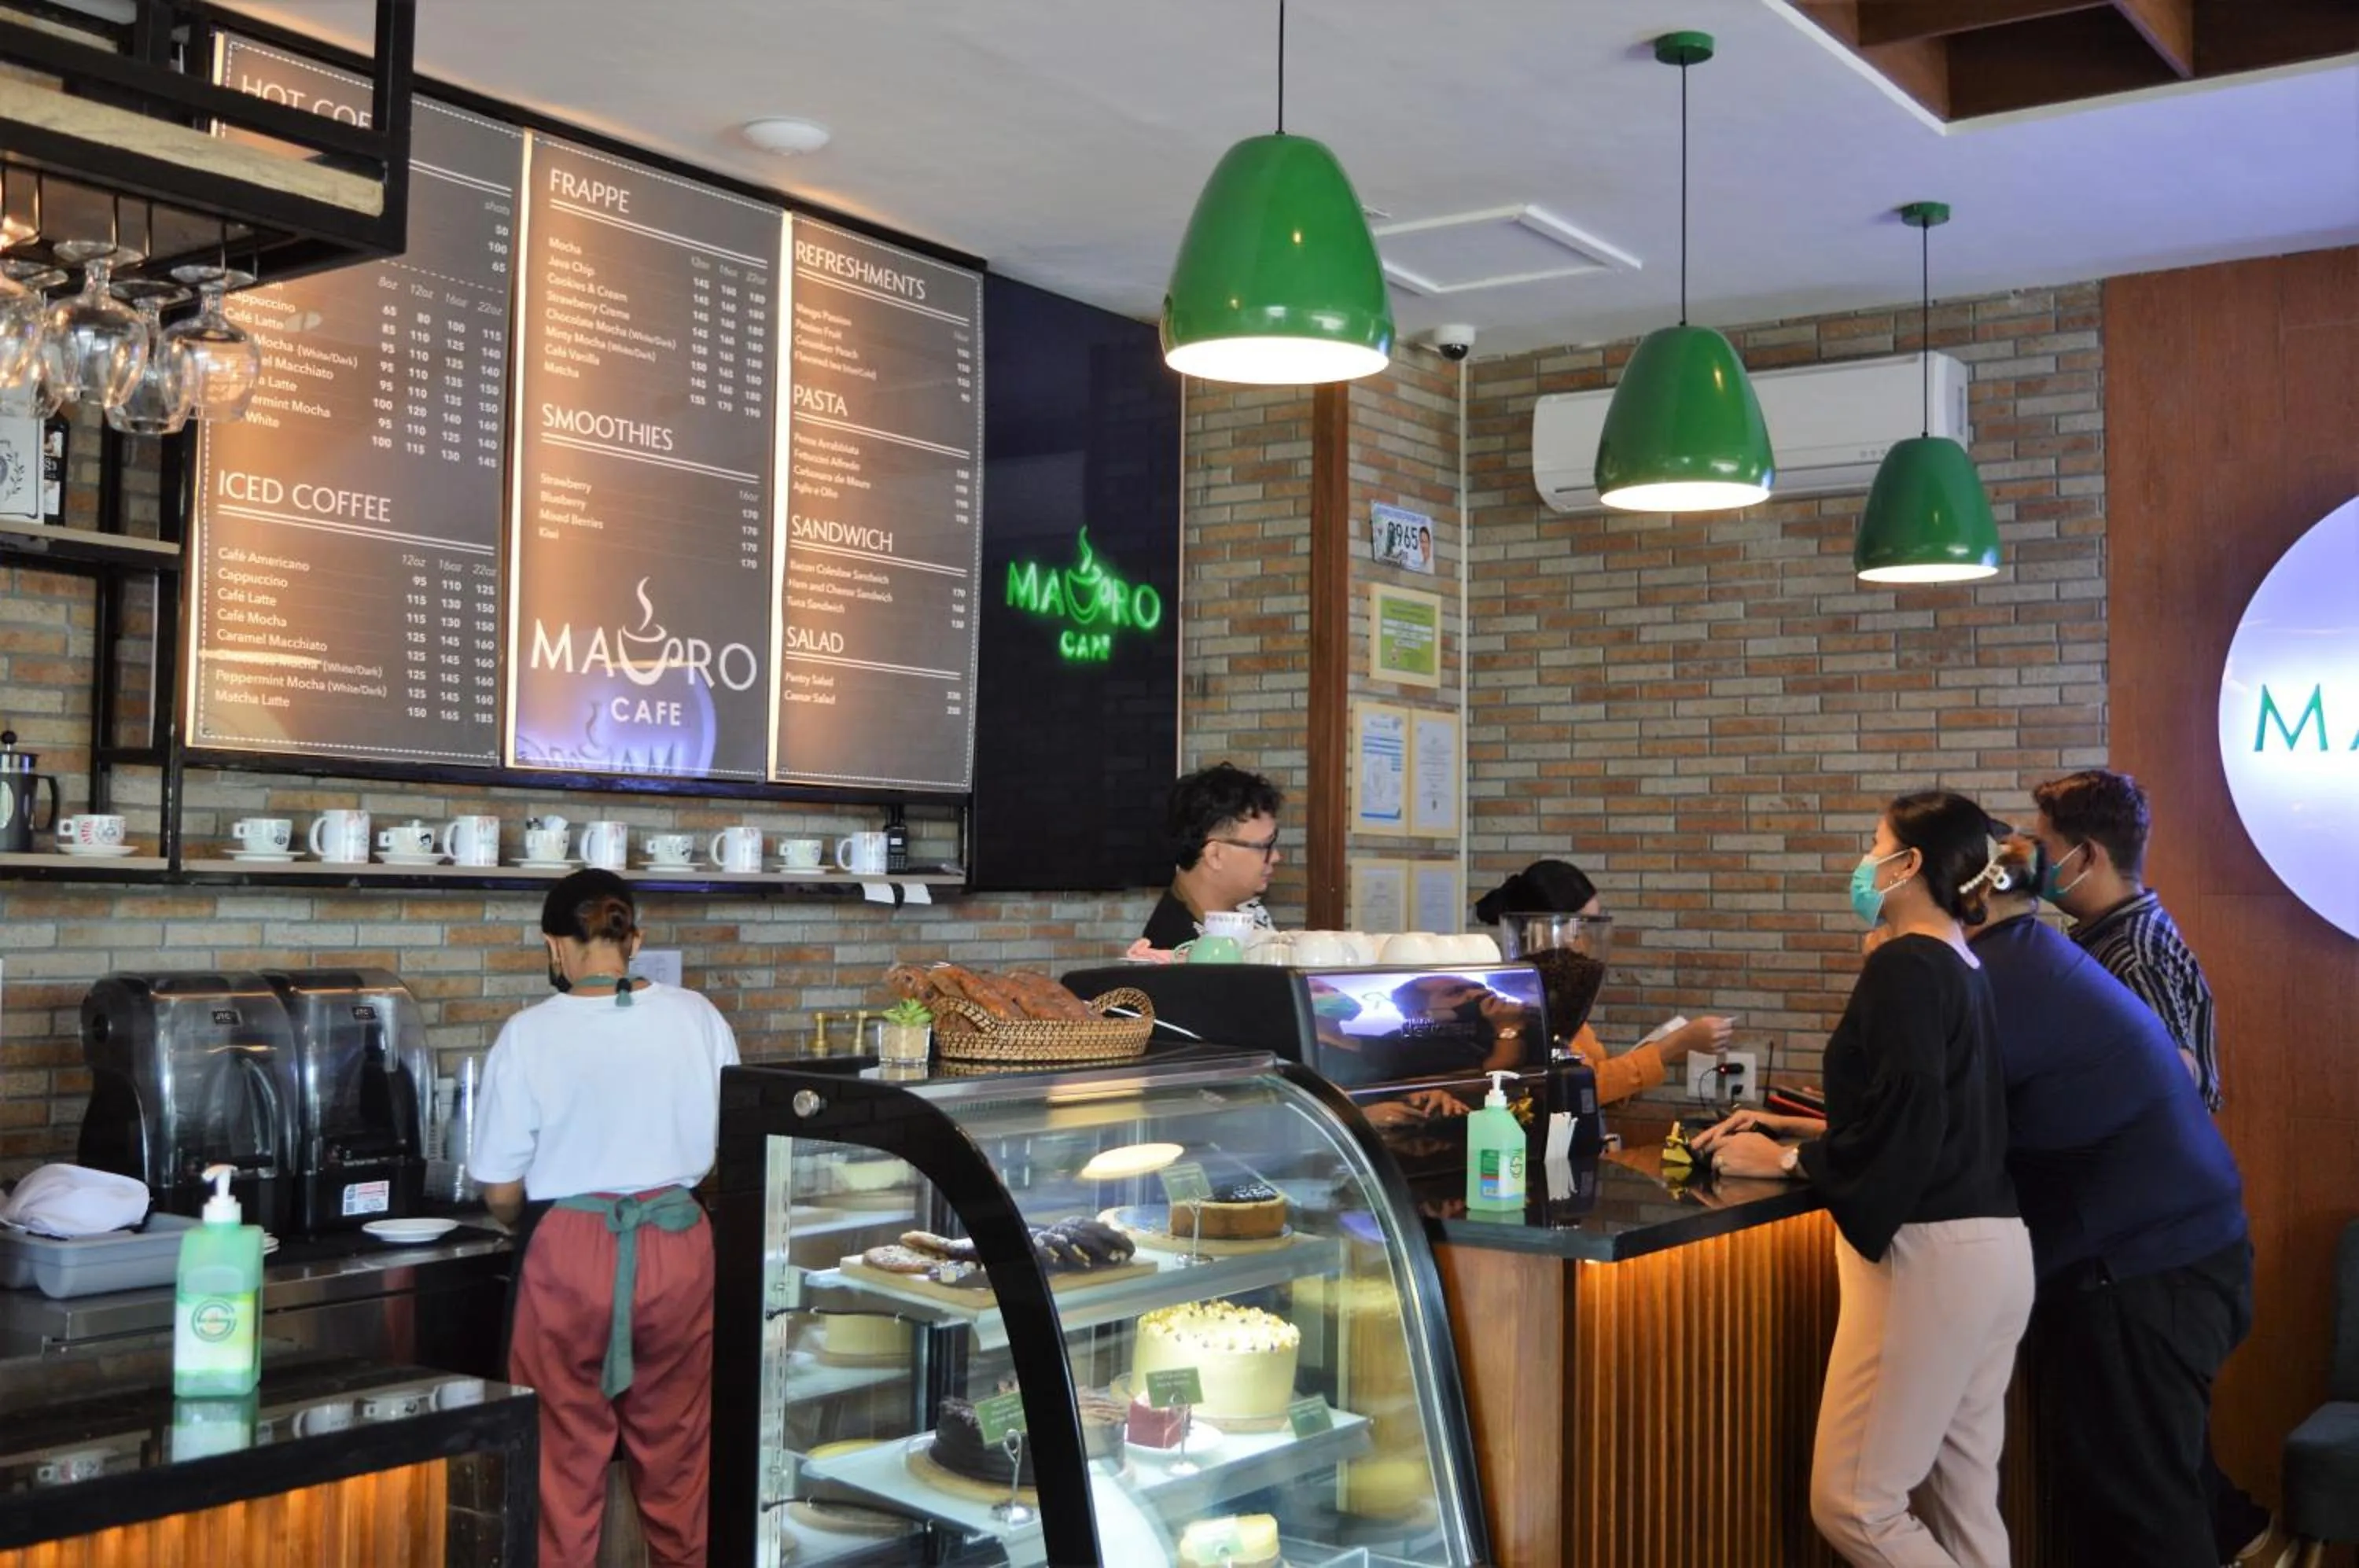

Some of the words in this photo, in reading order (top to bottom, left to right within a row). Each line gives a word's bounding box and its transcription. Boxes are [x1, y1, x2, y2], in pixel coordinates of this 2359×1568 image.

[550, 167, 631, 213] FRAPPE
[549, 237, 581, 255] Mocha
[796, 240, 926, 300] REFRESHMENTS
[547, 272, 586, 292] Cookies
[546, 290, 598, 314] Strawberry
[255, 315, 284, 329] Latte
[595, 319, 627, 337] Mocha
[254, 333, 293, 352] Mocha
[575, 332, 606, 349] Mocha
[275, 357, 334, 380] Macchiato
[409, 368, 428, 380] 110
[268, 377, 298, 392] Latte
[408, 387, 427, 399] 110
[292, 401, 331, 418] Mocha
[374, 398, 392, 410] 100
[793, 385, 848, 417] PASTA
[245, 412, 280, 428] White
[407, 424, 425, 436] 110
[542, 403, 673, 451] SMOOTHIES
[372, 436, 392, 448] 100
[540, 473, 592, 495] Strawberry
[218, 470, 284, 504] ICED
[293, 484, 392, 523] COFFEE
[540, 491, 587, 511] Blueberry
[539, 508, 569, 524] Mixed
[572, 513, 604, 528] Berries
[791, 514, 893, 552] SANDWICH
[218, 547, 245, 561] Café
[248, 553, 310, 572] Americano
[402, 554, 426, 567] 12oz
[218, 568, 288, 587] Cappuccino
[442, 580, 462, 591] 110
[248, 593, 277, 606] Latte
[407, 594, 427, 605] 115
[248, 613, 287, 628] Mocha
[407, 613, 426, 624] 115
[217, 629, 267, 645] Caramel
[269, 636, 328, 652] Macchiato
[407, 631, 425, 643] 125
[787, 626, 845, 653] SALAD
[531, 618, 756, 690] MAURO
[215, 670, 284, 688] Peppermint
[287, 676, 325, 690] Mocha
[215, 690, 258, 704] Matcha
[263, 694, 290, 707] Latte
[611, 697, 682, 726] CAFE
[2254, 683, 2359, 751] M
